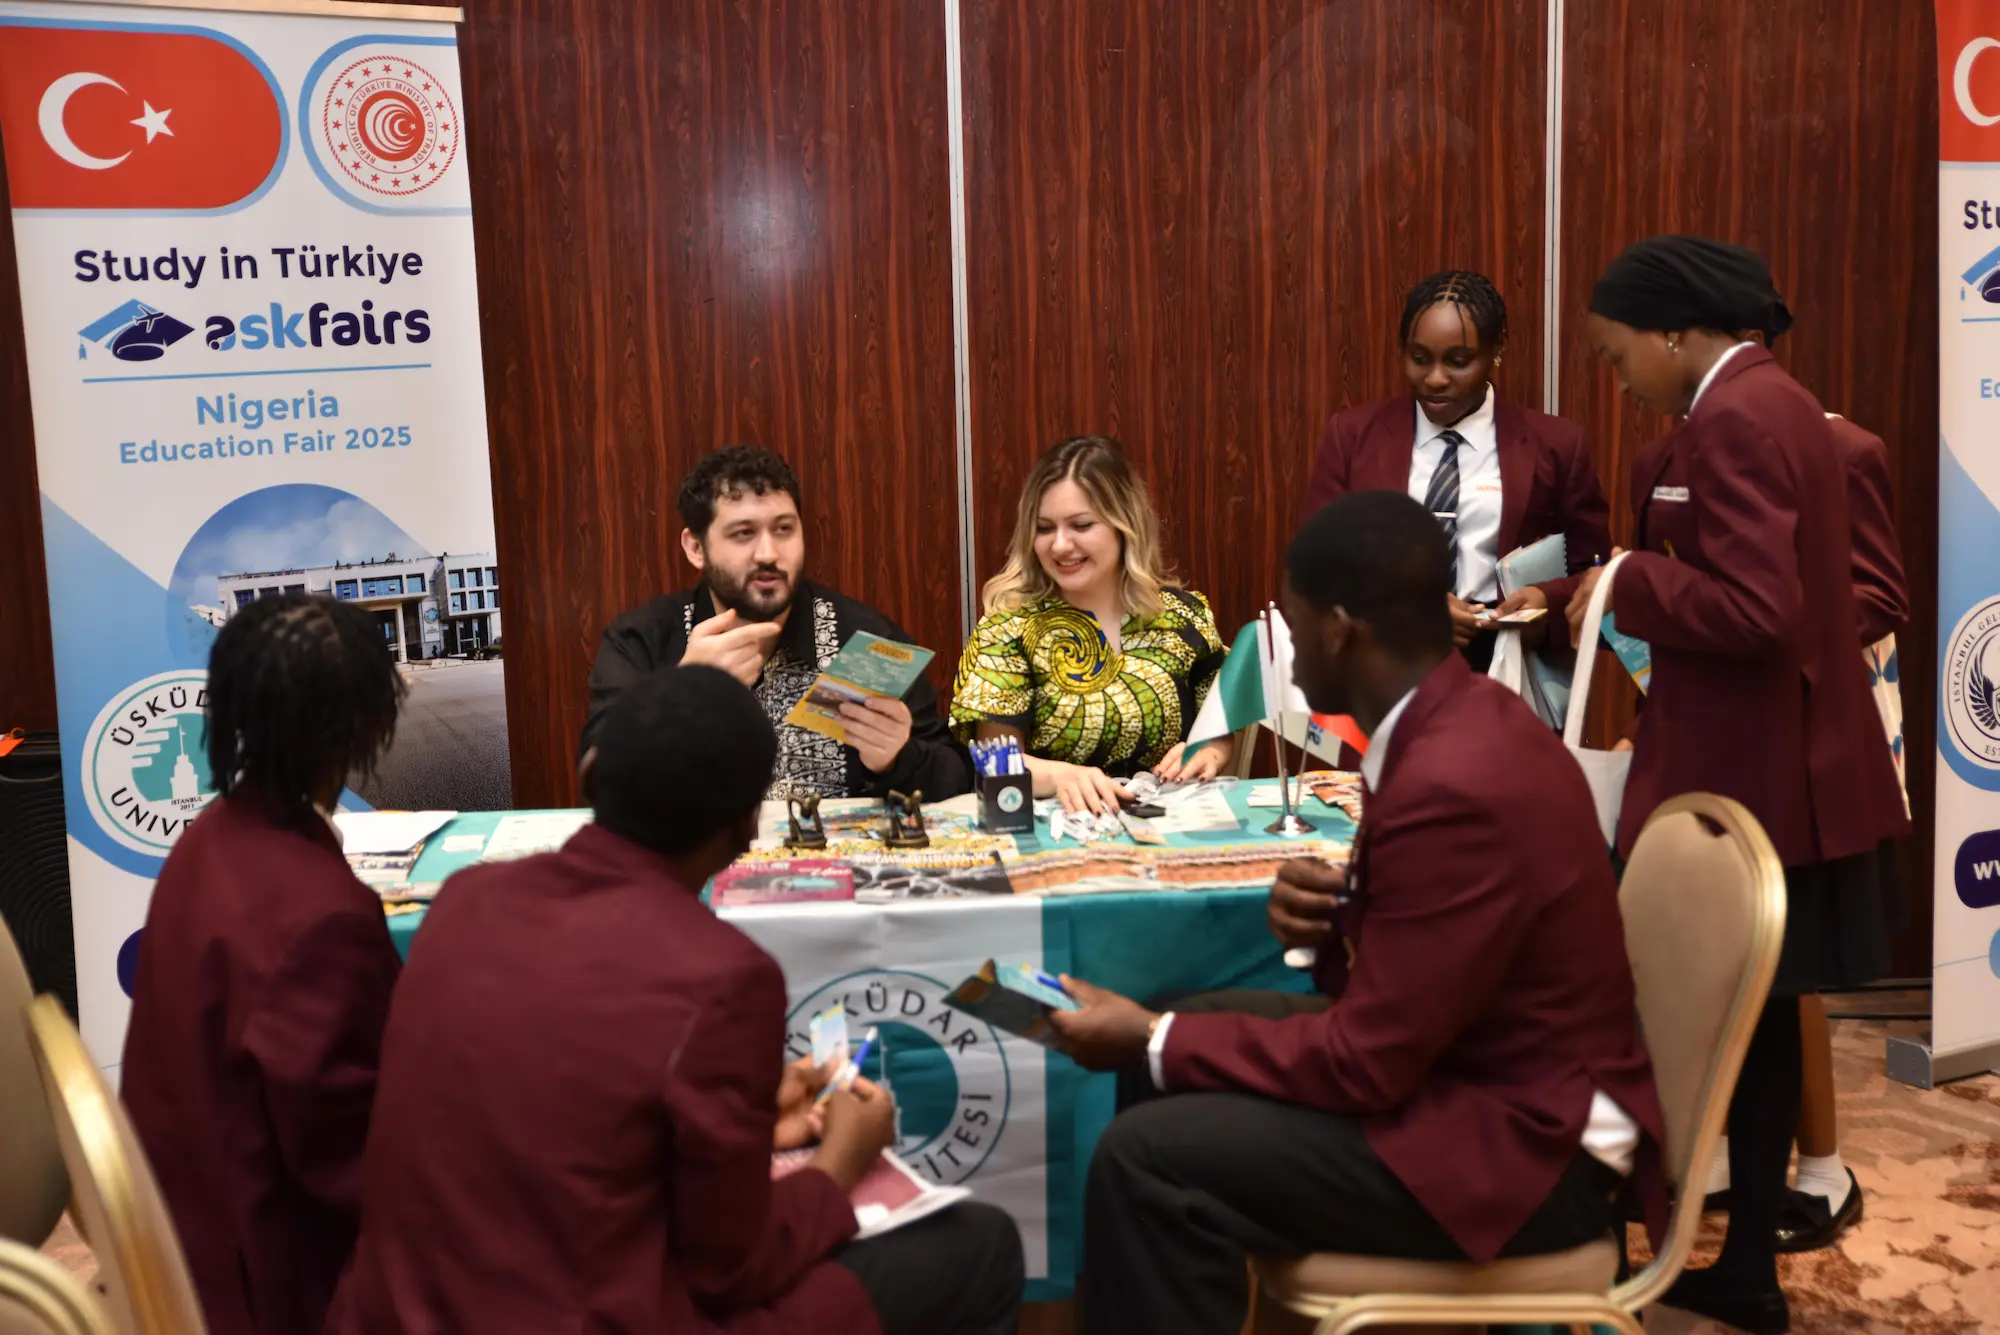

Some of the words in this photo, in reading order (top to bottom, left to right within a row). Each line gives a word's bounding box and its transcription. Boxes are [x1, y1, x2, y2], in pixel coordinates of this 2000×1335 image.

[355, 80, 392, 102] TÜRKİYE
[394, 82, 432, 117] MINISTRY
[349, 104, 359, 117] OF
[426, 121, 434, 134] OF
[348, 121, 377, 165] REPUBLIC
[412, 137, 434, 165] TRADE
[1963, 199, 2000, 230] St
[74, 247, 206, 289] Study
[220, 246, 258, 280] in
[271, 244, 424, 285] Türkiye
[204, 299, 431, 352] askfairs
[196, 389, 340, 430] Nigeria
[119, 432, 274, 465] Education
[284, 430, 336, 455] Fair
[345, 425, 413, 450] 2025
[784, 981, 979, 1059] ÜKÜDAR
